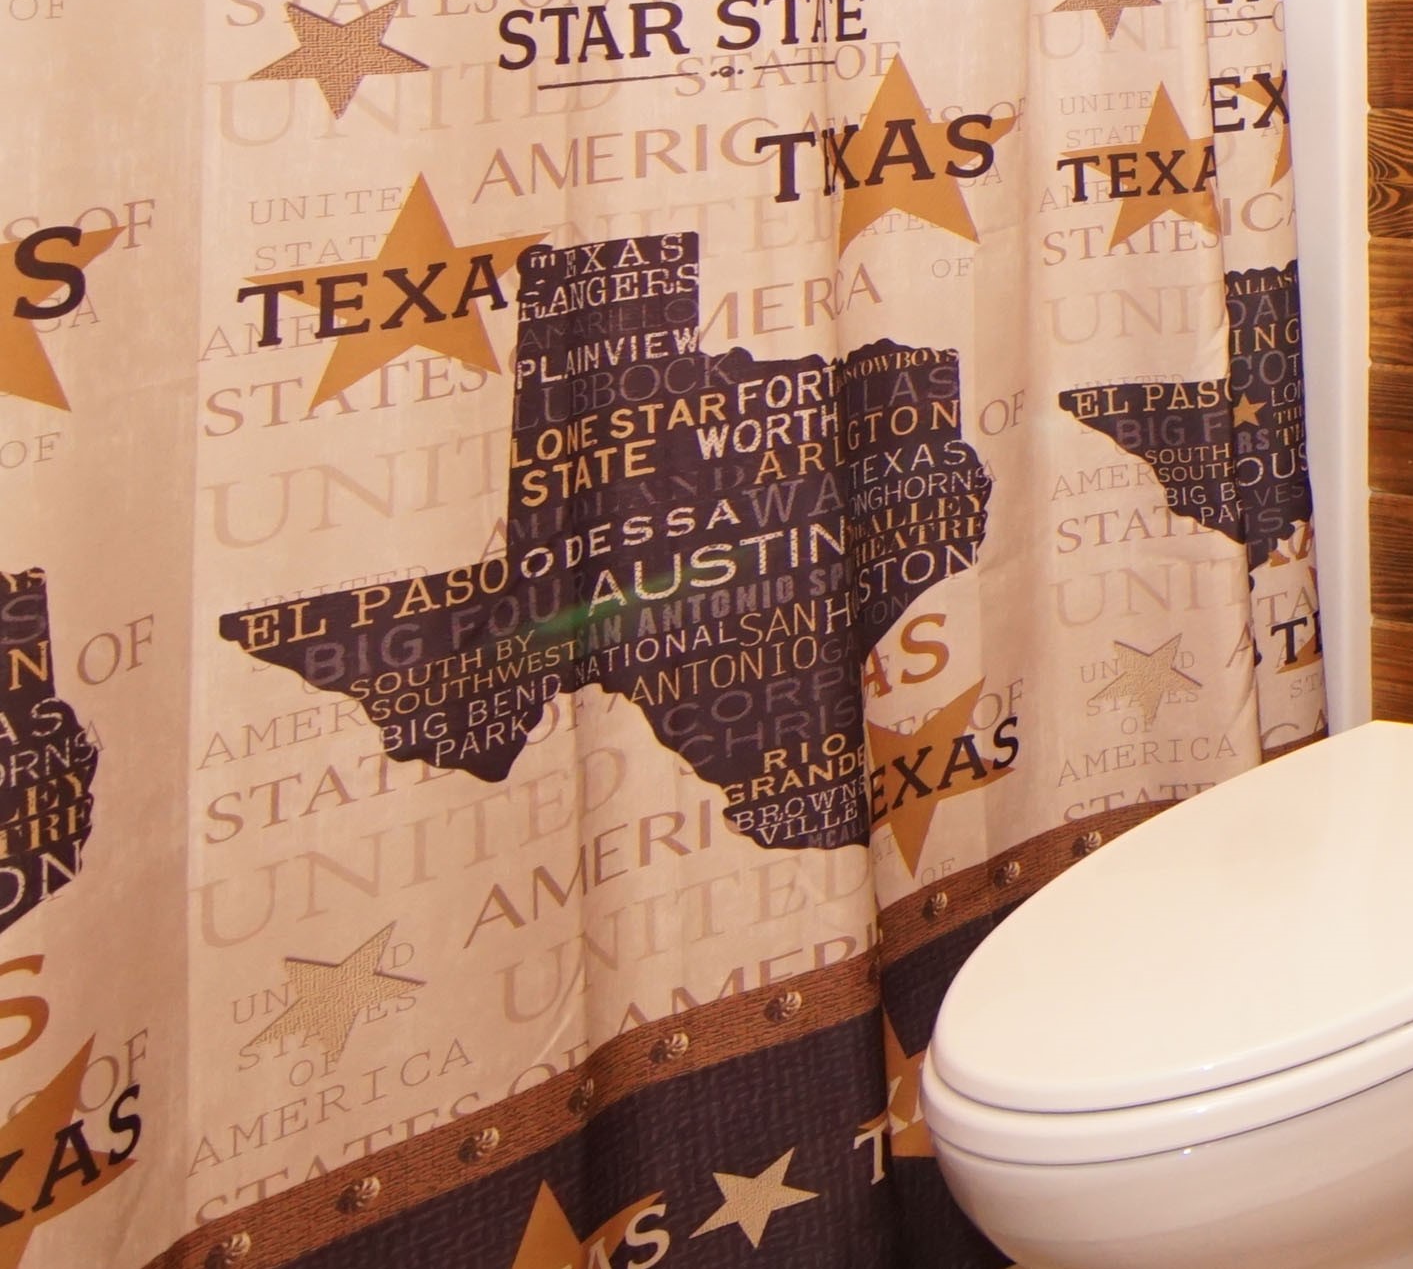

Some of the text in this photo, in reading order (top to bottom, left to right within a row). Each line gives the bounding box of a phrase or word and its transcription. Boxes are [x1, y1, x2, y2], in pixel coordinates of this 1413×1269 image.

[498, 1, 690, 70] STAR
[1059, 90, 1154, 116] UNITE
[249, 185, 405, 226] UNITE
[1056, 145, 1219, 204] TEXA
[254, 233, 388, 273] STAT
[930, 257, 974, 280] OF
[236, 252, 509, 348] TEXA
[518, 262, 700, 324] RANGERS
[516, 325, 700, 391] PLAINVIEW
[514, 354, 736, 432] LUBBOCK
[737, 364, 838, 415] FORT
[978, 389, 1026, 437] OF
[1071, 387, 1129, 420] EL
[511, 391, 727, 469] LONE STAR
[696, 399, 839, 461] WORTH
[1115, 414, 1186, 451] BIG
[1143, 442, 1232, 467] SOUTH
[202, 425, 514, 550] UNIT
[520, 439, 657, 509] STATE
[849, 439, 968, 491] TEXAS
[1050, 461, 1153, 502] AMER
[1157, 461, 1236, 484] SOUTH
[1164, 485, 1207, 508] BIG
[520, 498, 742, 580] ODESSA
[588, 515, 847, 618] AUSTIN
[239, 600, 327, 653] EL
[350, 554, 510, 629] PASO
[738, 597, 818, 649] SAN
[77, 614, 154, 685] OF
[304, 622, 424, 683] BIG
[349, 629, 536, 703] SOUTH BY
[371, 639, 578, 721] SOUTHWEST
[575, 619, 739, 684] NATIONAL
[629, 634, 818, 707] ANTONIO
[196, 697, 370, 771] AMER
[382, 672, 562, 754] BIG BEND
[434, 710, 530, 768] PARK
[722, 743, 867, 807] GRANDE
[762, 731, 848, 775] RIO
[869, 716, 1020, 821] EXAS
[1058, 732, 1238, 788] AMERICA
[755, 800, 859, 846] VILLE
[463, 799, 713, 950] AMERI
[187, 1037, 474, 1179] AMERICA
